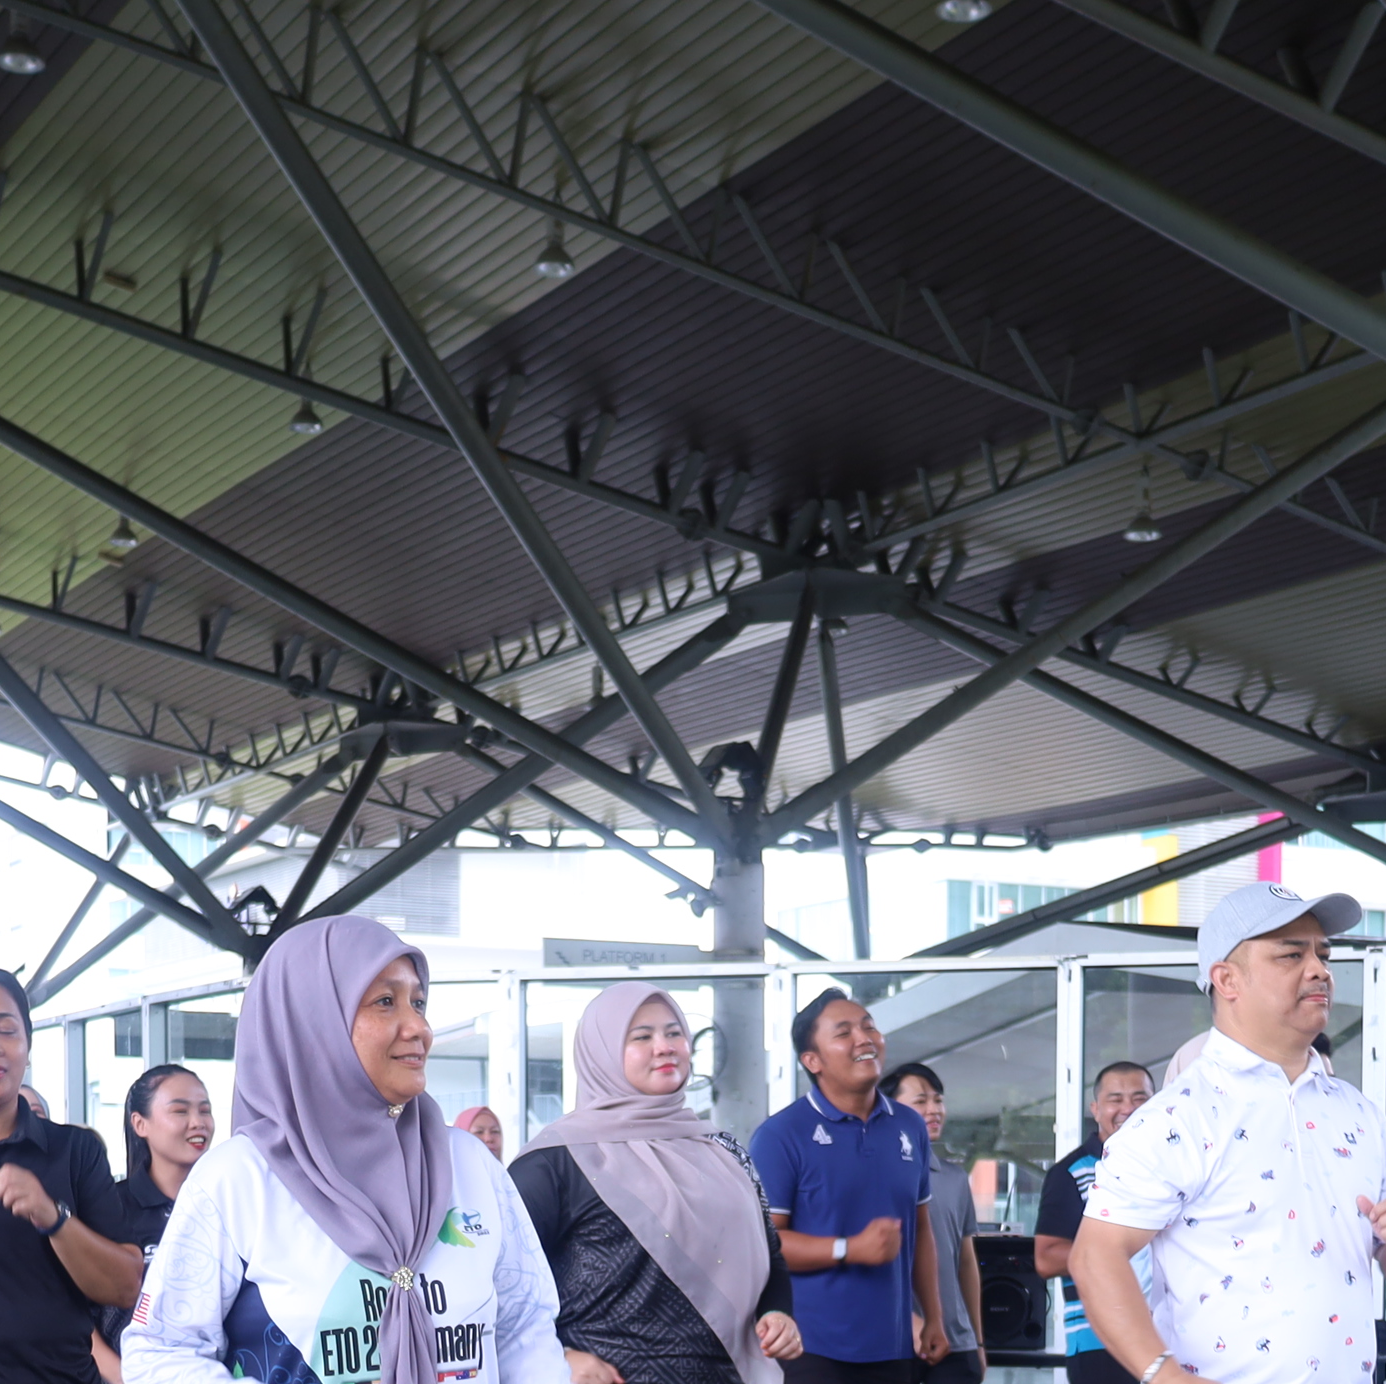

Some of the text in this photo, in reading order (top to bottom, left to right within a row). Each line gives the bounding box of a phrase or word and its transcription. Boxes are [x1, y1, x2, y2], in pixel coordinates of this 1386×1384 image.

[582, 949, 654, 963] PLATFORM
[419, 1273, 448, 1316] to
[320, 1326, 361, 1377] ETO
[436, 1322, 486, 1370] many
